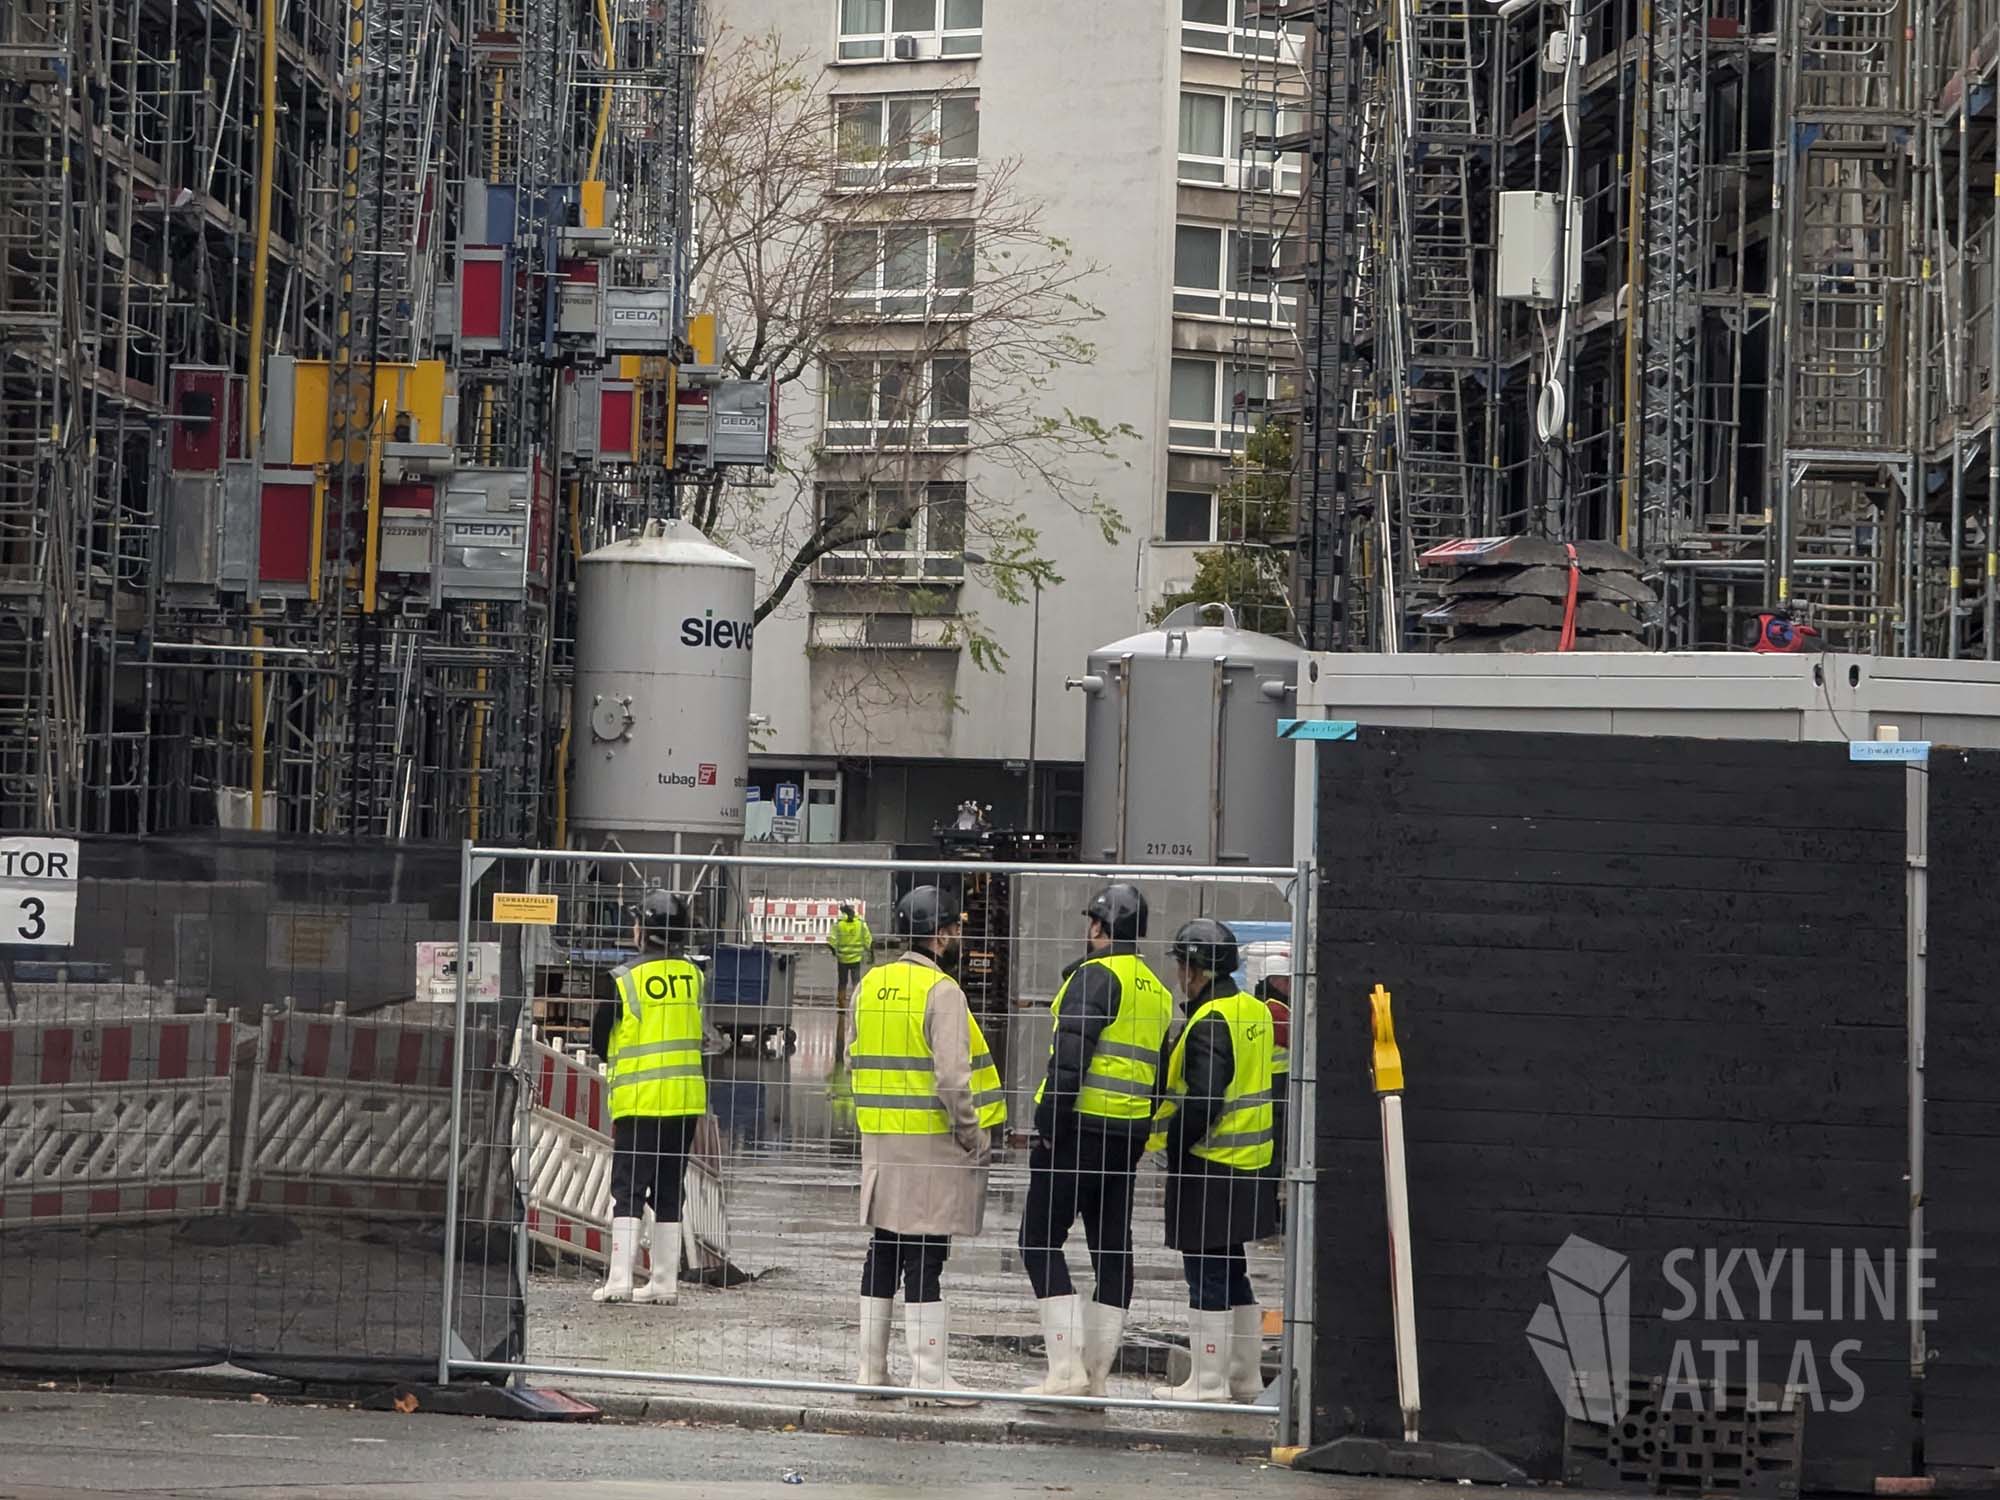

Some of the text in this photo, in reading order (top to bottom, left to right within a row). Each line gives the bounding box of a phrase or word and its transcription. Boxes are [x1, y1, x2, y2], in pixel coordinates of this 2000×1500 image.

[614, 310, 658, 321] GEDA
[721, 417, 757, 426] GEDA
[454, 523, 511, 537] GEDA
[658, 772, 696, 788] tubag
[1146, 843, 1193, 856] 217.034
[1, 851, 68, 877] TOR
[18, 897, 46, 940] 3
